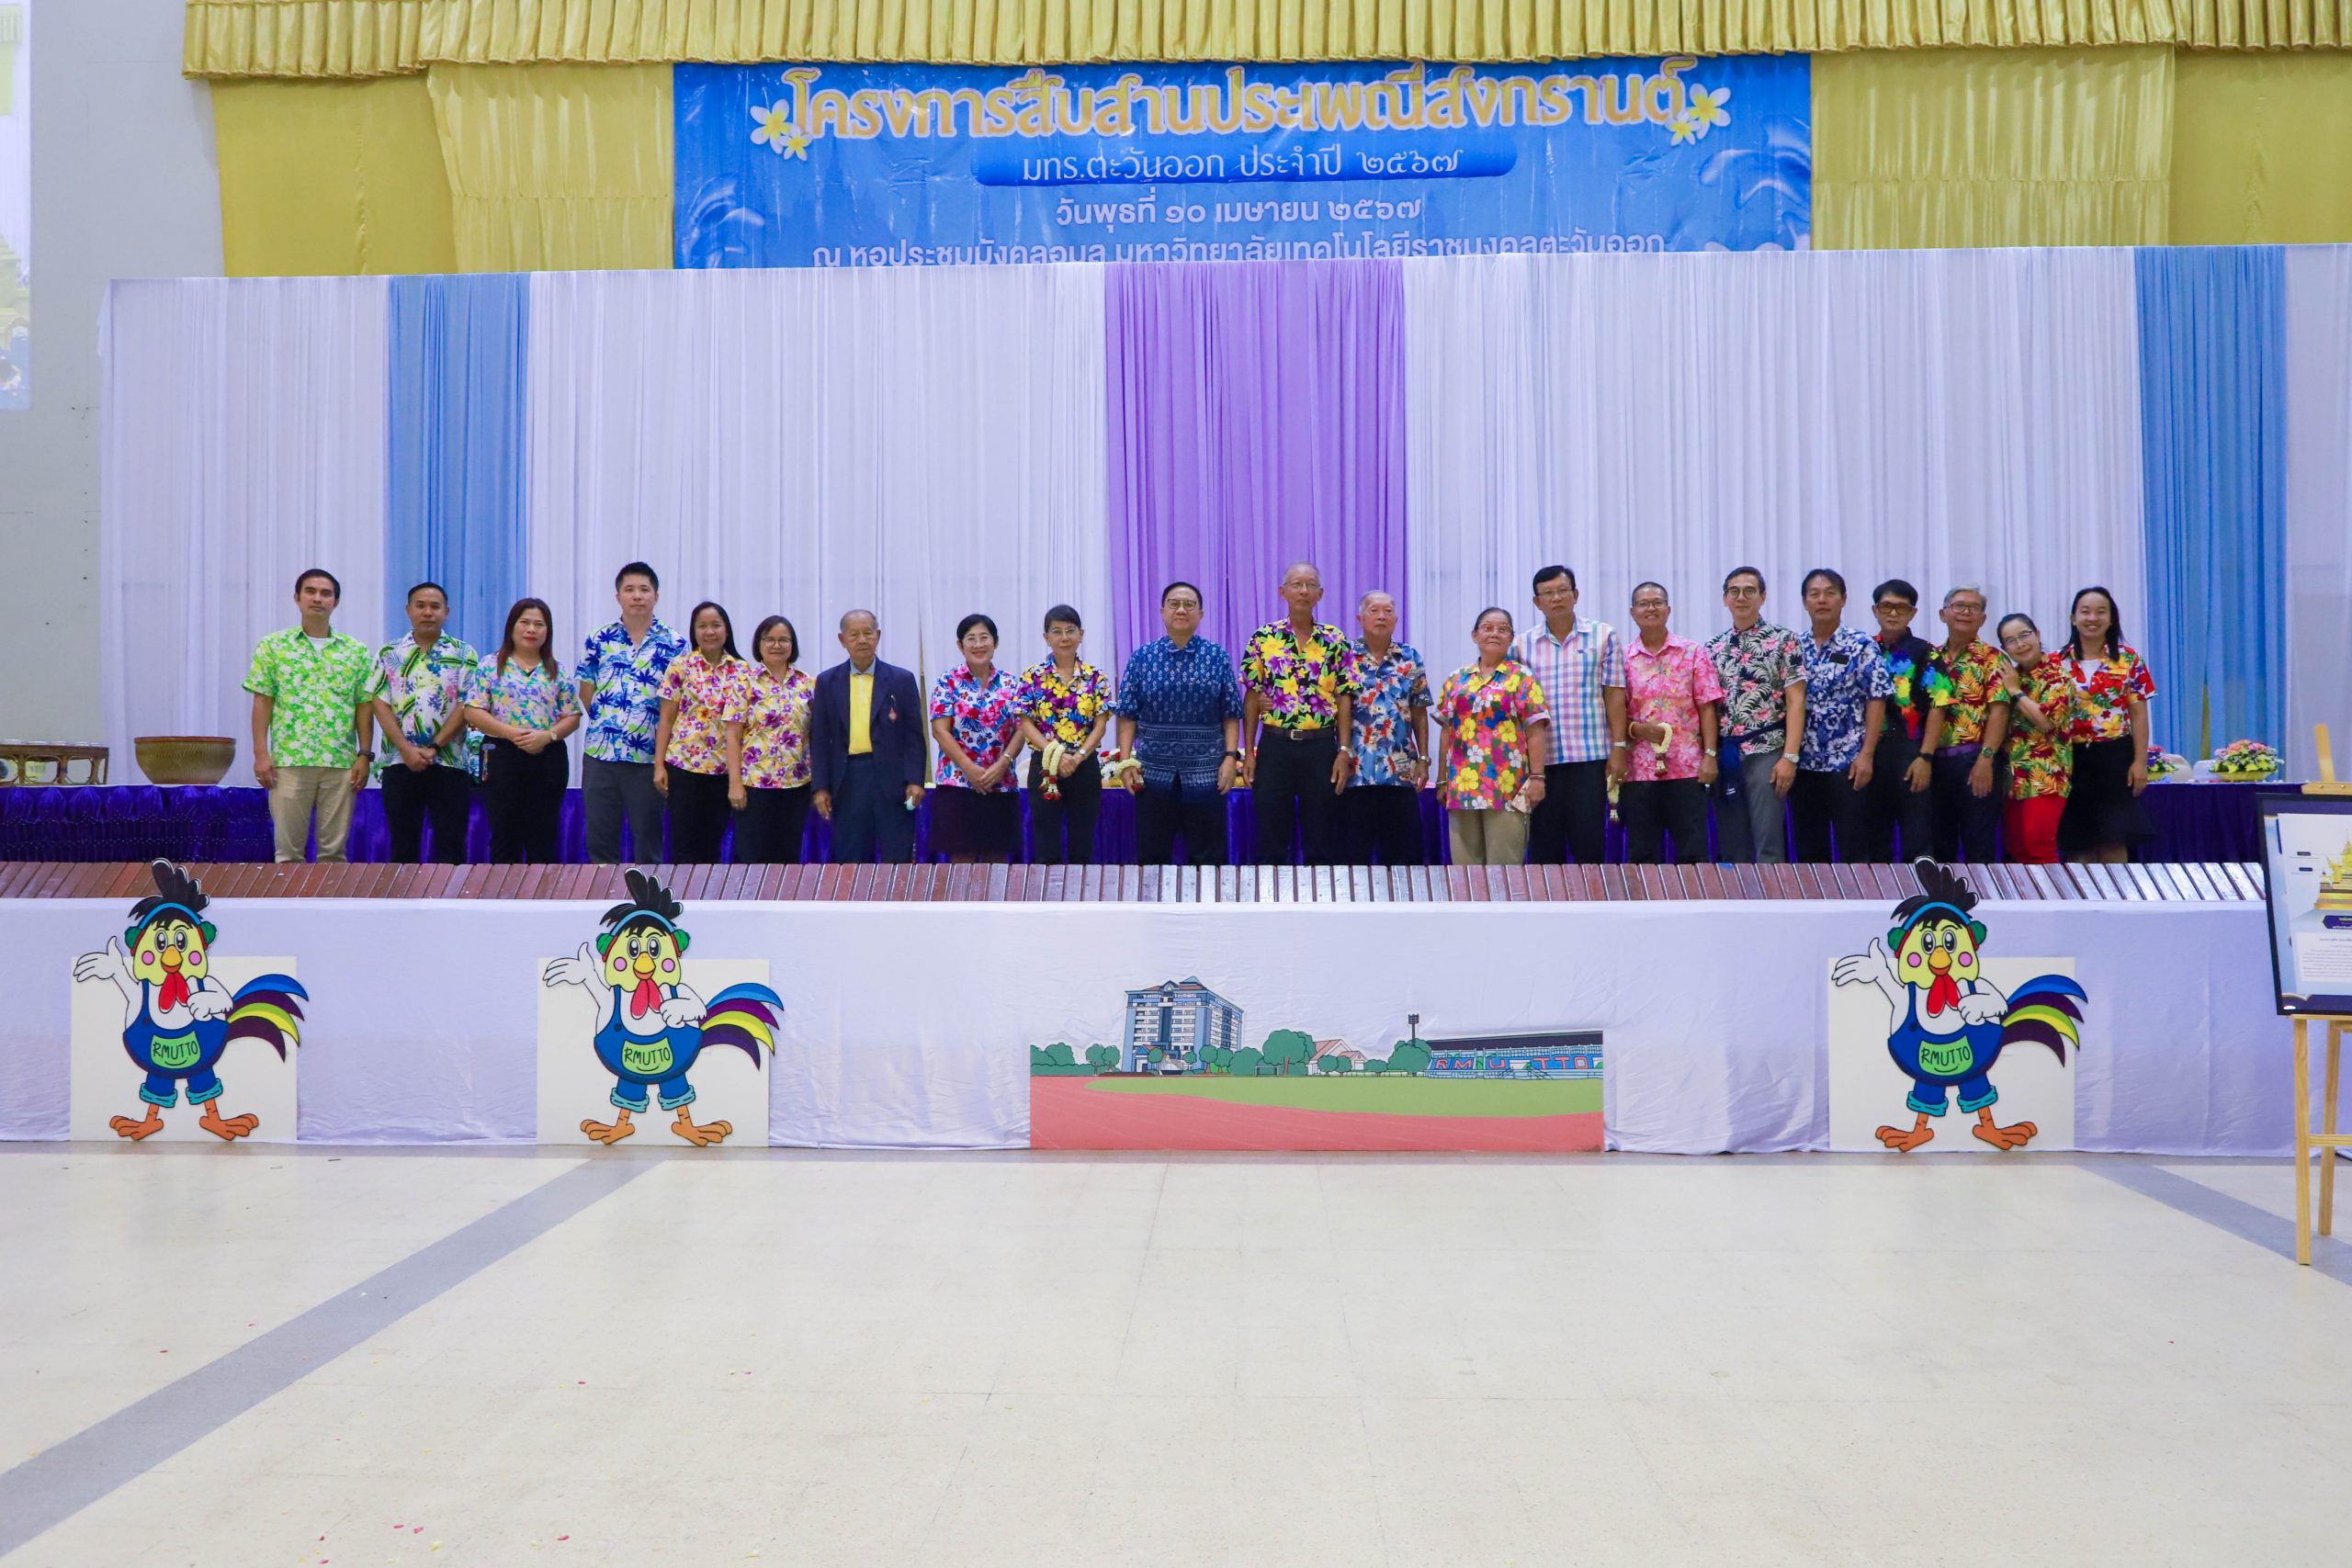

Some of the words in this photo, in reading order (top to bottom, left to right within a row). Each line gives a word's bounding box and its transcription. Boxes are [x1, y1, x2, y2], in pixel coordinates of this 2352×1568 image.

[783, 57, 1698, 137] โครงการสืบสานประเพณีสงกรานต์
[1023, 147, 1225, 181] มทร.ตะวันออก
[1240, 143, 1341, 176] ประจำปี
[1356, 149, 1463, 175] ๒๕๖๗
[1057, 186, 1156, 233] วันพุธที่
[1165, 204, 1206, 224] ๑๐
[1216, 200, 1319, 223] เมษายน
[1328, 198, 1421, 220] ๒๕๖๗
[813, 247, 842, 267] ณ
[153, 1040, 198, 1060] RMUTTO
[625, 1047, 671, 1066] RMUTTO
[1920, 1045, 1971, 1066] RMUTTO
